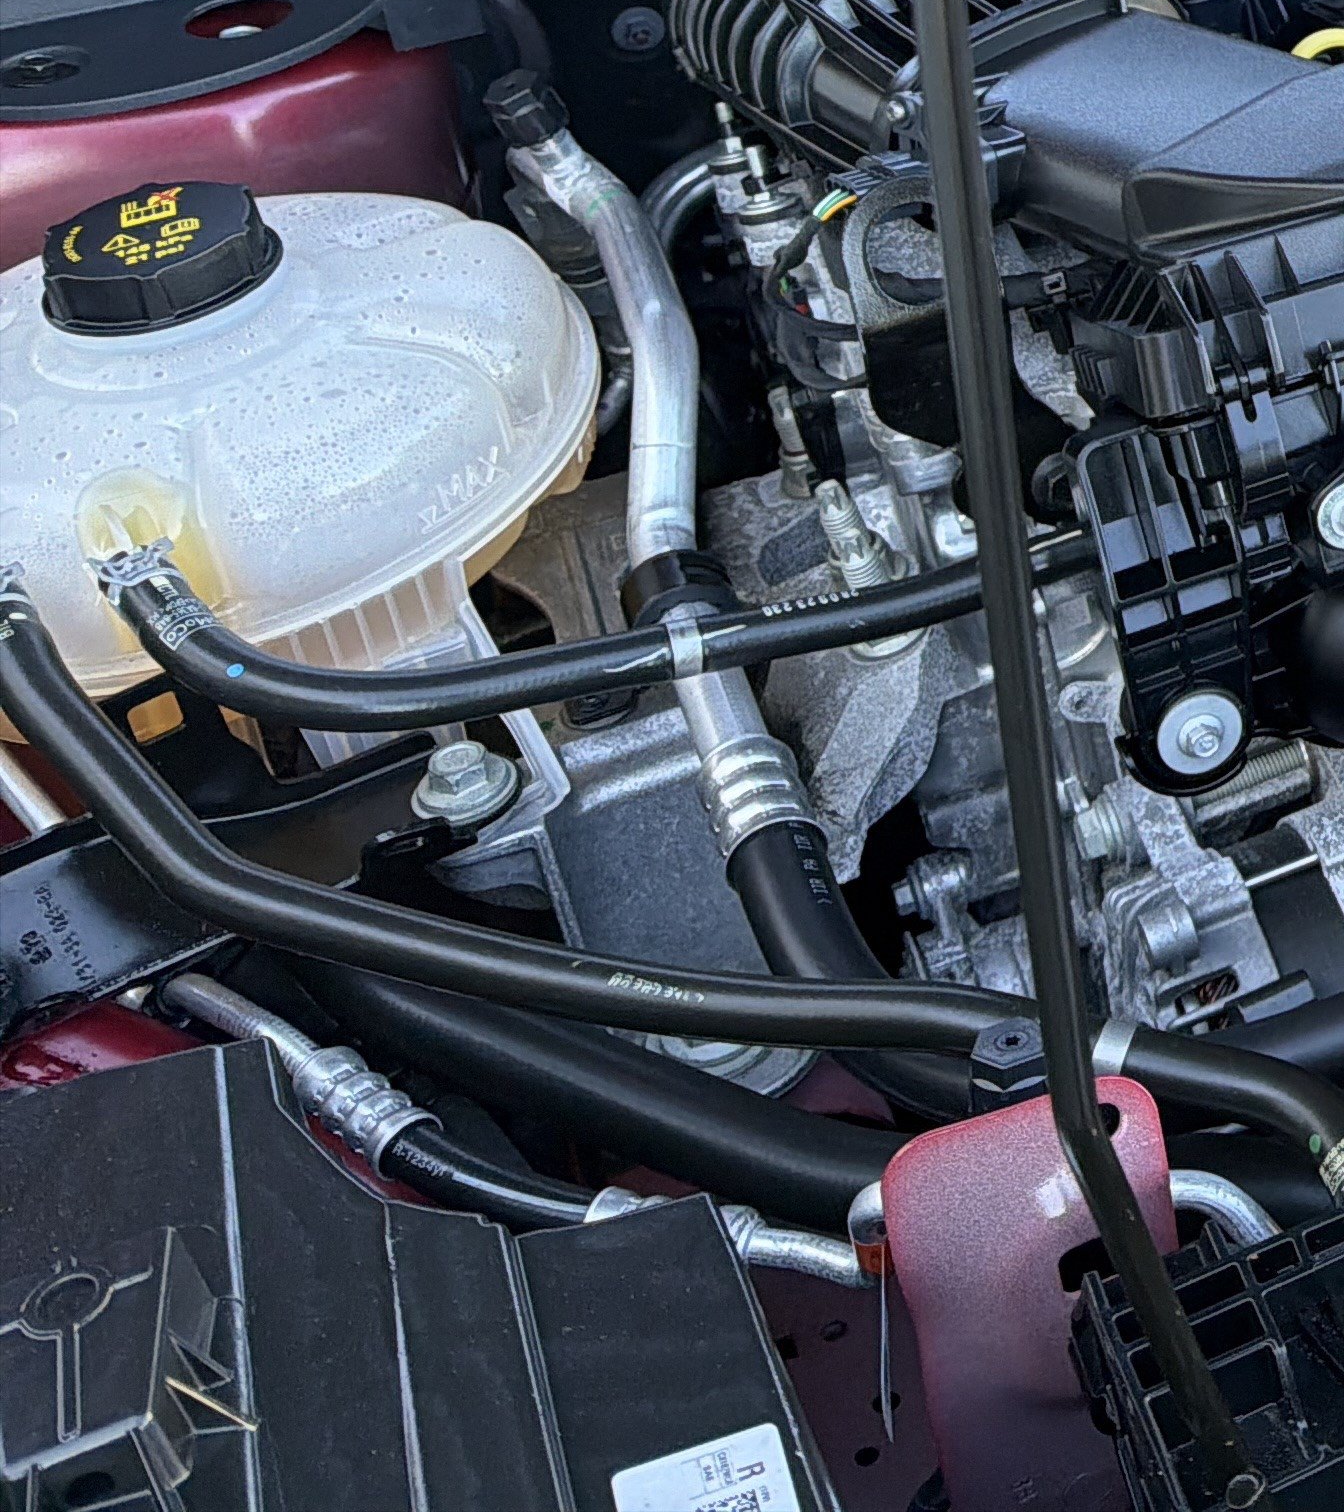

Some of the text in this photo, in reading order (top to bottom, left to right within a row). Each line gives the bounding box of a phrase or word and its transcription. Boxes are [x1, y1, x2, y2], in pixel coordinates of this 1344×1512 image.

[437, 445, 505, 516] MAX
[391, 1141, 449, 1177] R-1234yf
[736, 1460, 767, 1482] R
